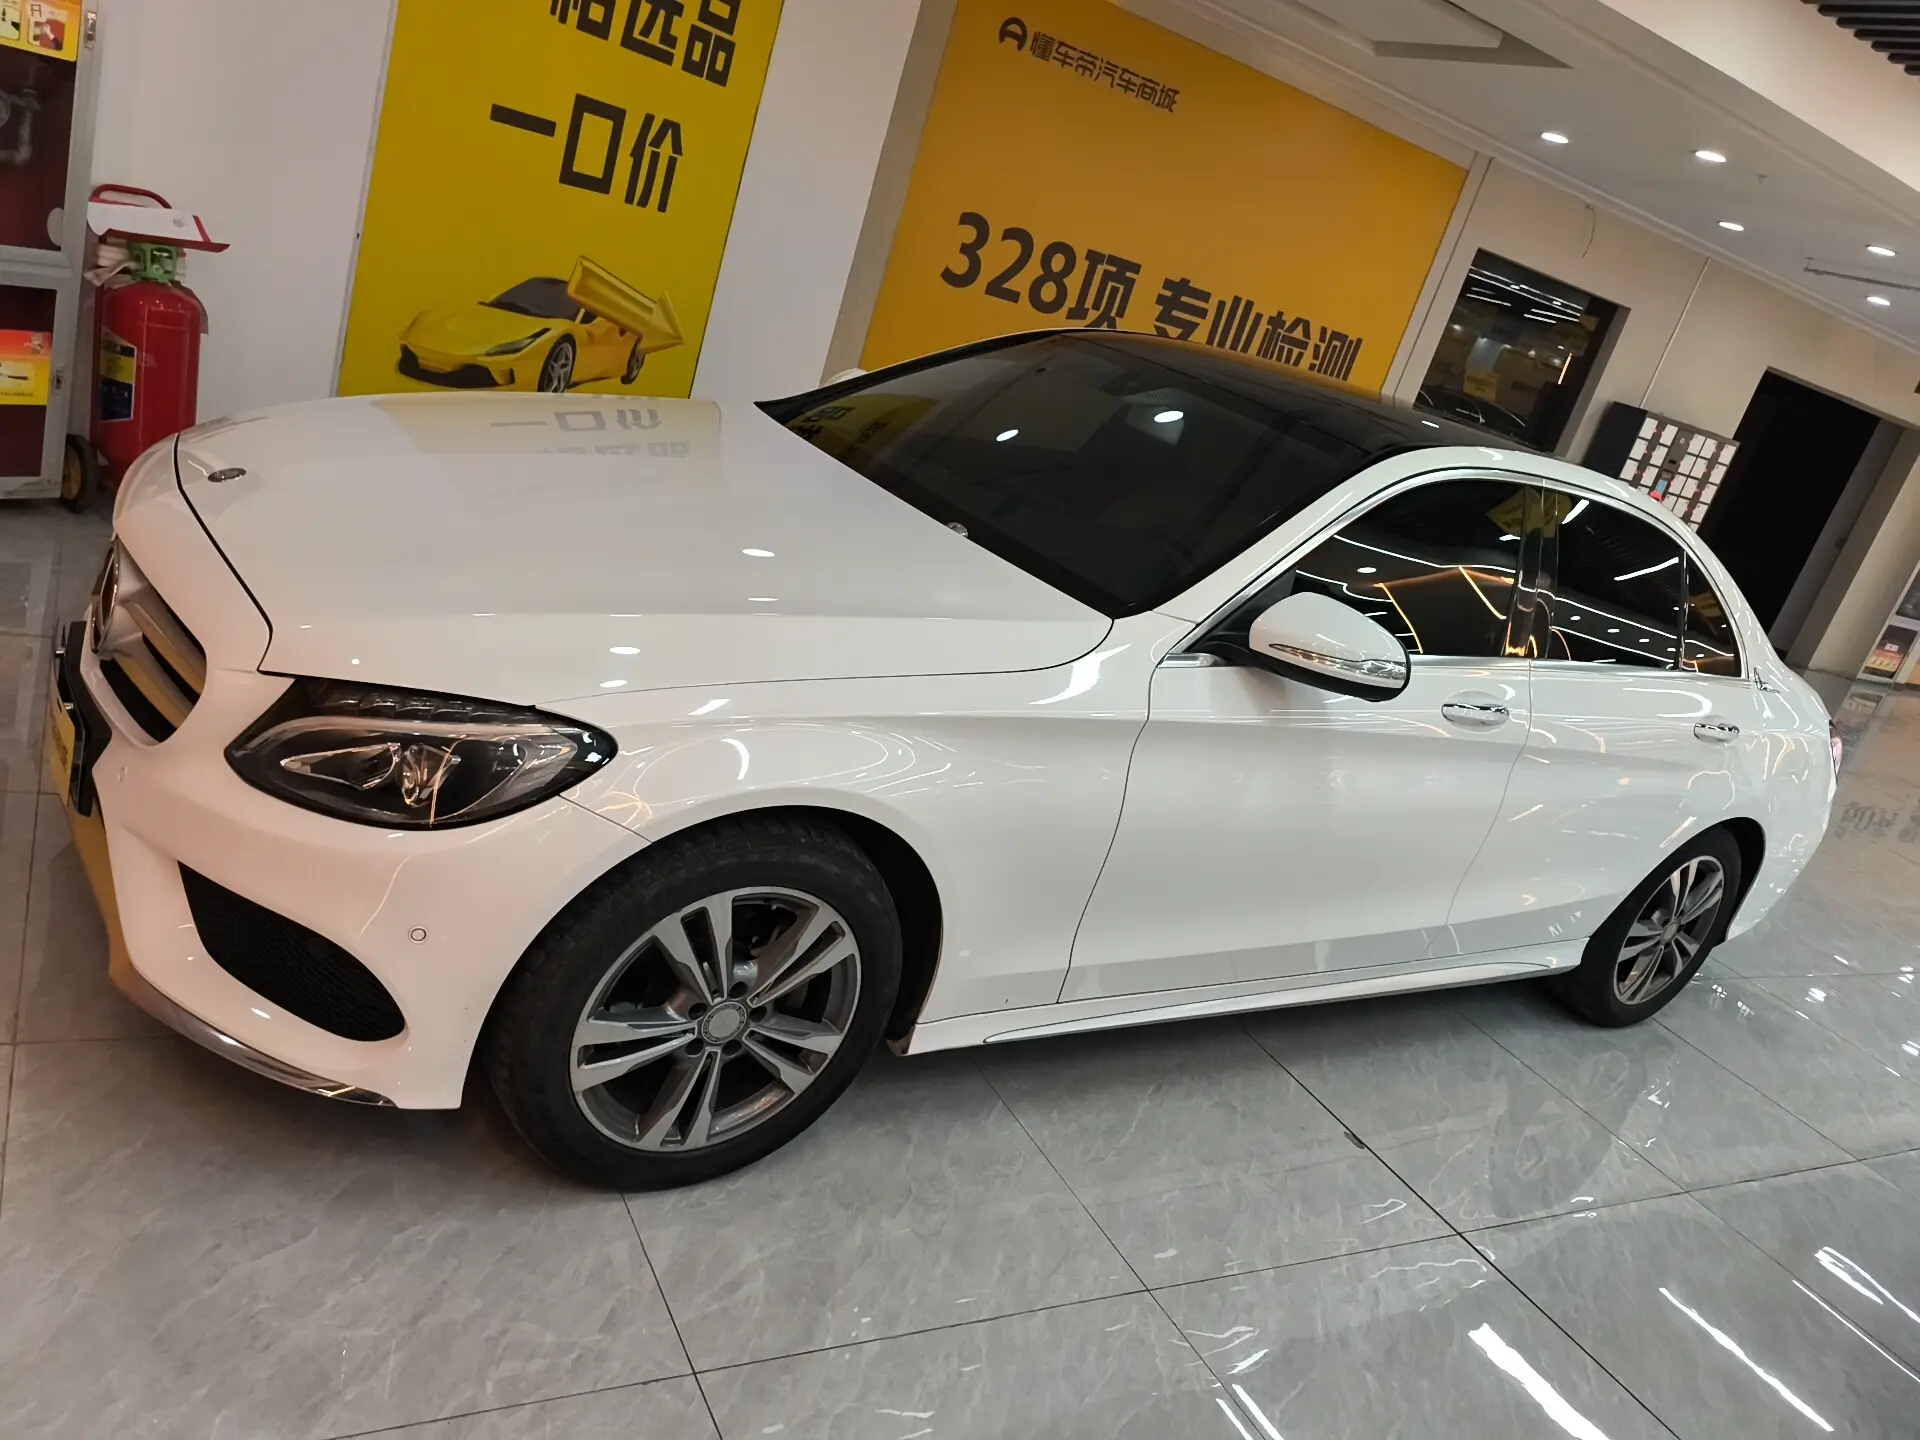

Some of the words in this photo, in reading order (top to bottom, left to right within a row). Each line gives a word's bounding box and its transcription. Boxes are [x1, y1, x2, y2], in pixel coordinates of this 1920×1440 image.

[1029, 31, 1181, 113] 懂车帝汽车商城
[489, 93, 684, 214] 一口价
[940, 211, 1143, 330] 328项
[1152, 277, 1363, 381] 专业检测
